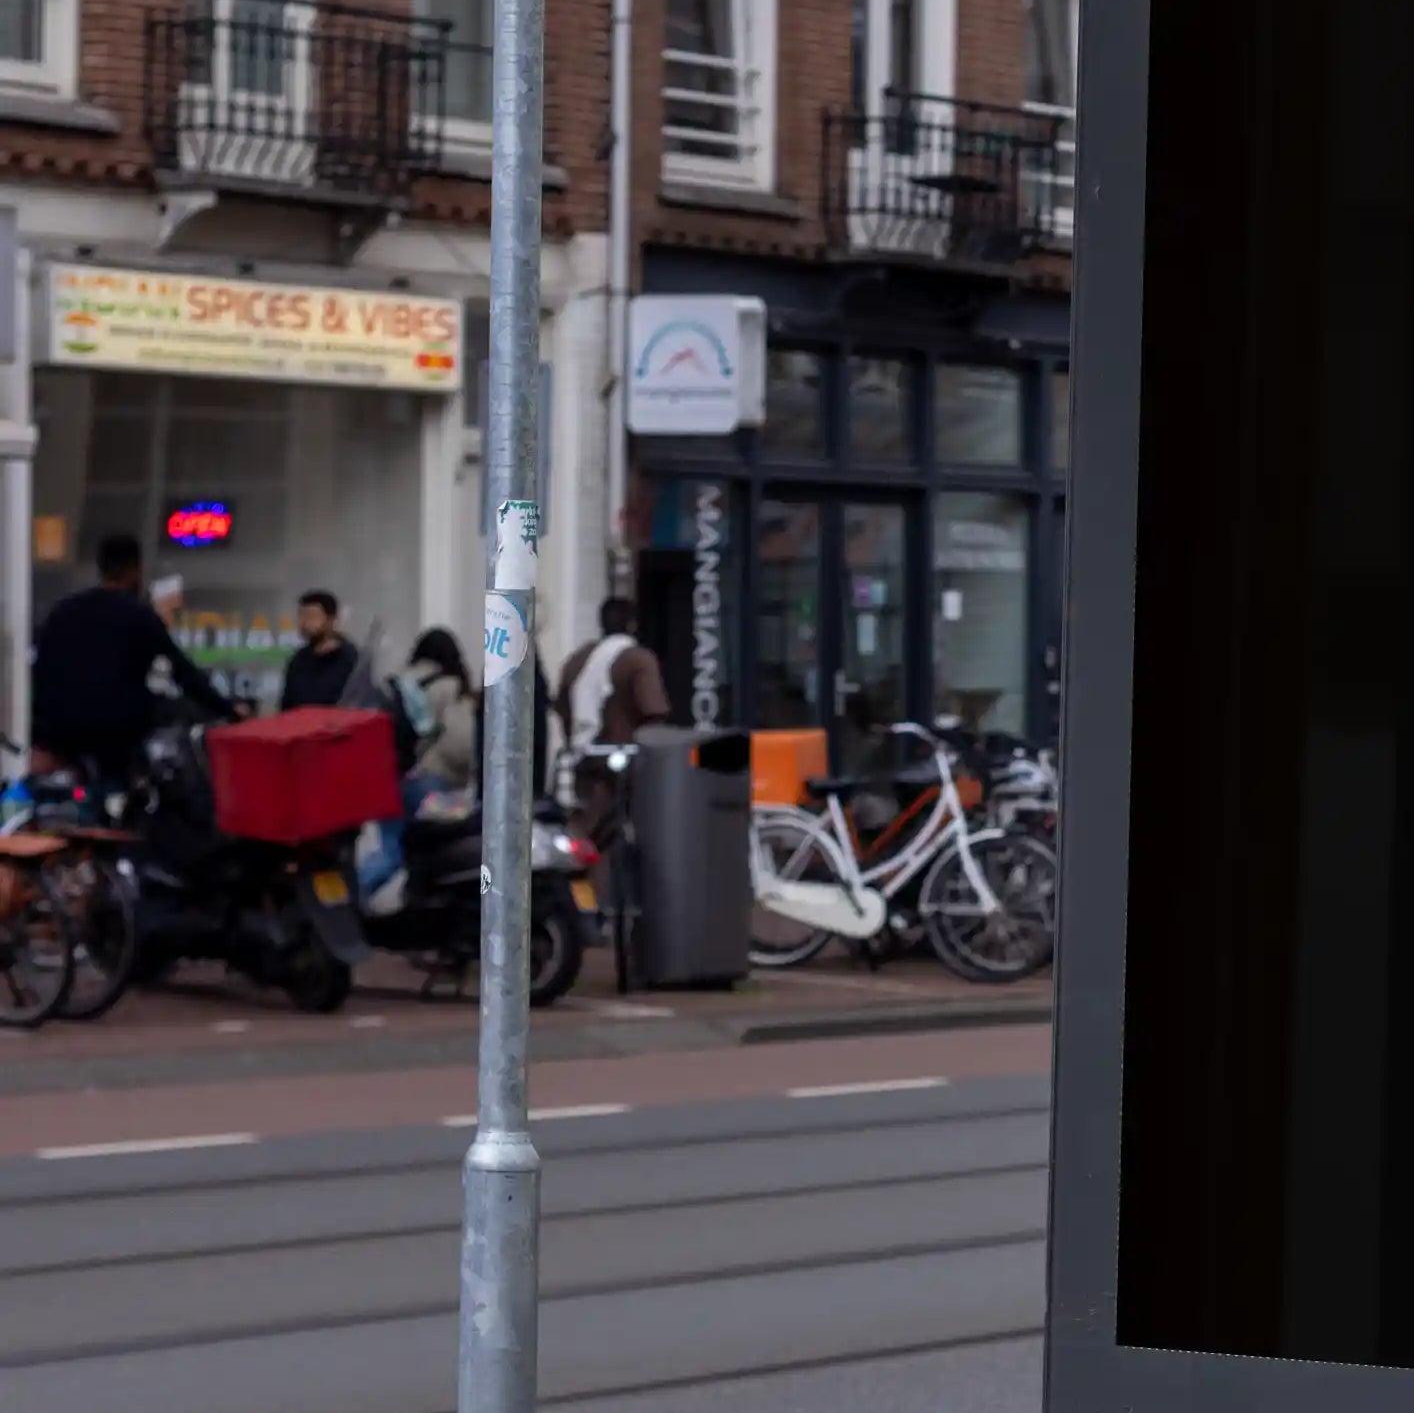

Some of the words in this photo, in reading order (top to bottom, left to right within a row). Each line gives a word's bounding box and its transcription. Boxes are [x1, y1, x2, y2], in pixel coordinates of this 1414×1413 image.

[187, 285, 312, 332] SPICES
[322, 296, 350, 334] &
[360, 301, 459, 343] VIBES
